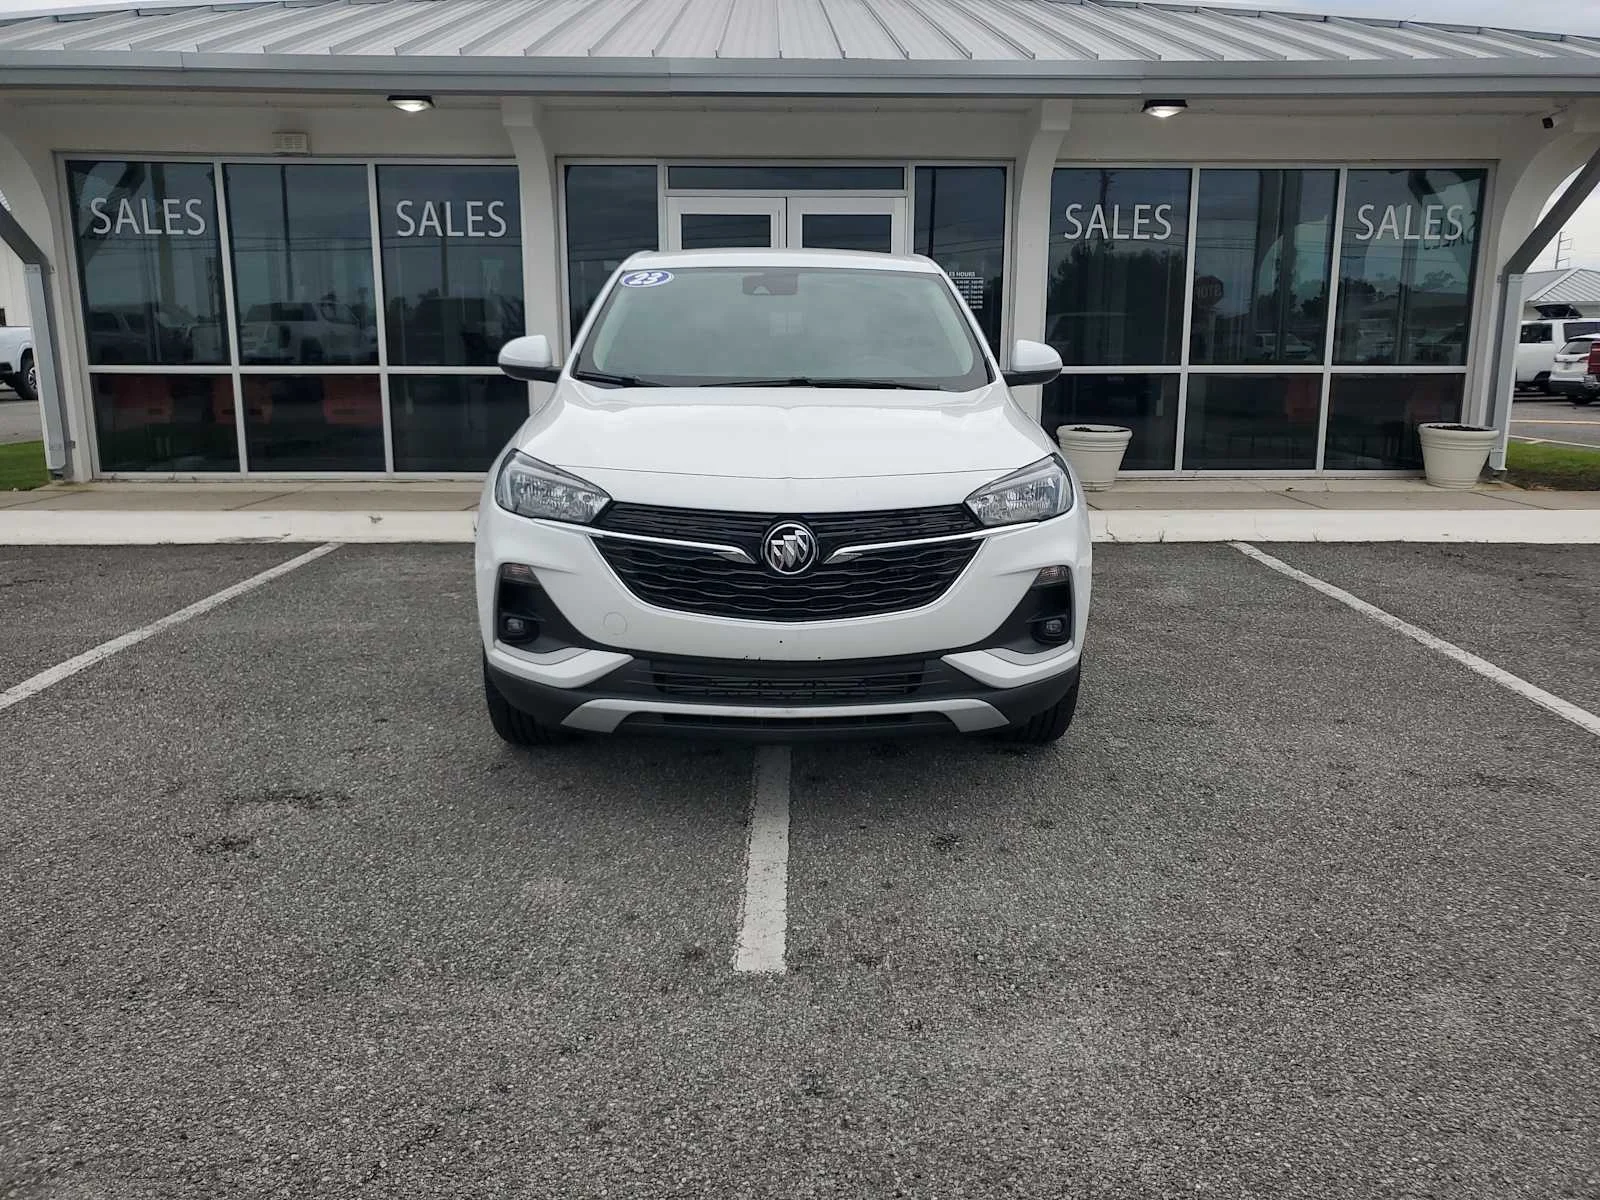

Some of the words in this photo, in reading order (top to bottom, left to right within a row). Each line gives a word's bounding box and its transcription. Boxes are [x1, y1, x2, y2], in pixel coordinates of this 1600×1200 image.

[90, 197, 206, 236] SALES
[396, 200, 507, 238] SALES
[1064, 203, 1173, 241] SALES
[1355, 203, 1464, 241] SALES
[628, 272, 664, 285] 23
